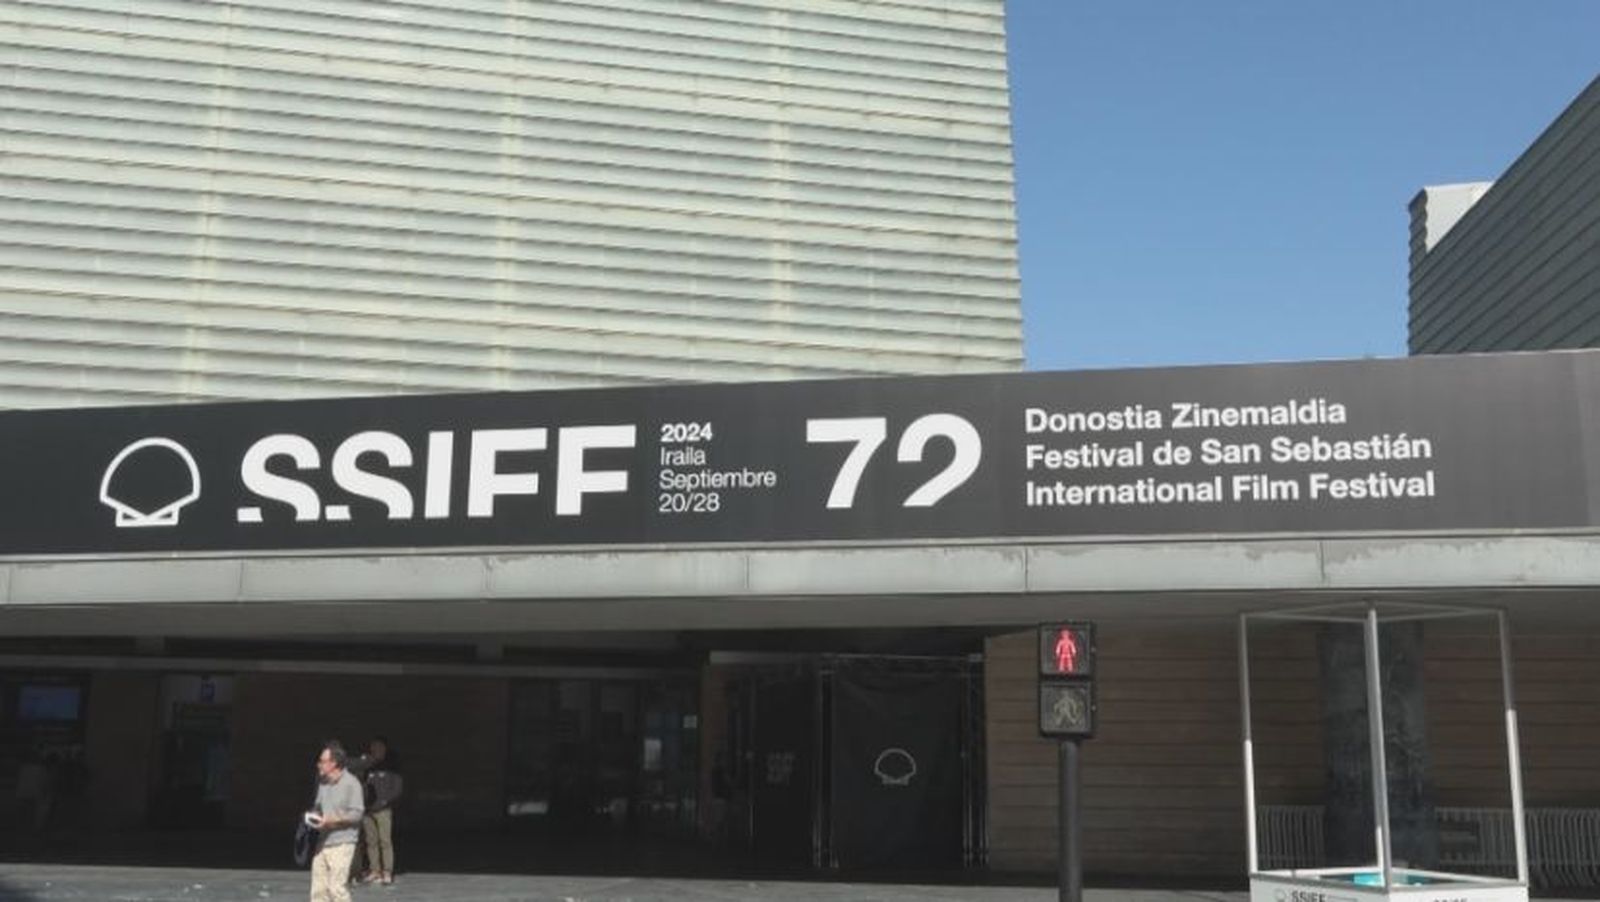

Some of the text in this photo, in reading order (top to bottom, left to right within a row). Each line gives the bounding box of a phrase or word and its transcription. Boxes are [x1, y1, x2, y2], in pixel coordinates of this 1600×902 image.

[660, 422, 713, 443] 2024
[1025, 399, 1347, 433] Donostia Zinemaldia
[660, 447, 706, 466] Iraila
[806, 413, 982, 509] 72
[1026, 432, 1432, 470] Festival de San Sebastián
[237, 424, 637, 523] SSIFF
[659, 468, 777, 492] Septiembre
[1026, 470, 1435, 506] International Film Festival
[659, 492, 720, 512] 20/28
